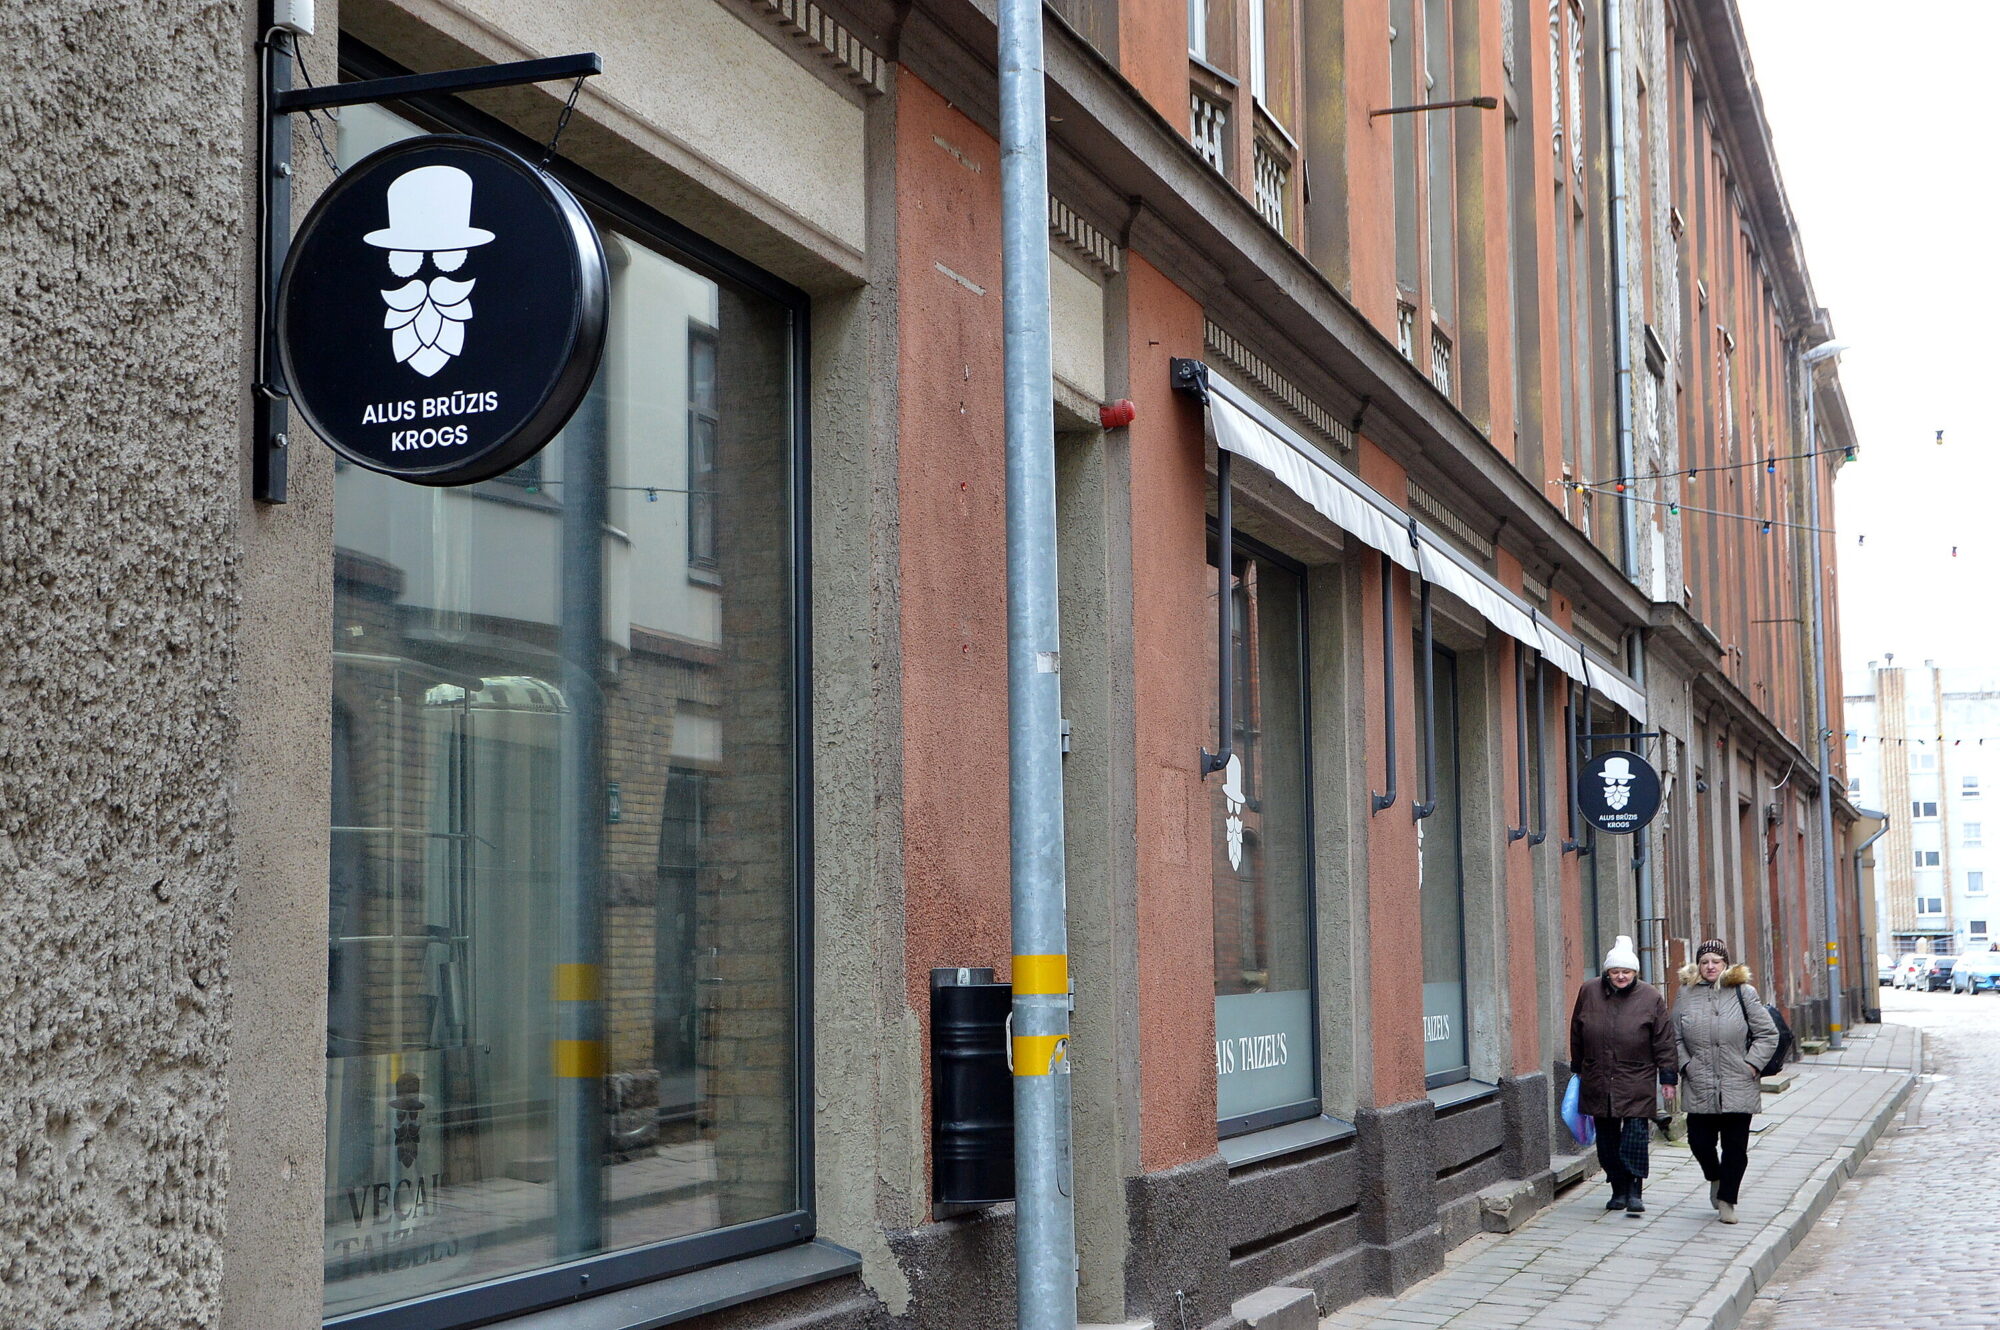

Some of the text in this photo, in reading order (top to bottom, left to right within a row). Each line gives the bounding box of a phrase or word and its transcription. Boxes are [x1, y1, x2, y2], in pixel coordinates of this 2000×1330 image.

[361, 391, 498, 425] ALUS BRŪZIS
[391, 425, 468, 451] KROGS
[1615, 812, 1638, 821] BRŪZIS
[1239, 1032, 1287, 1071] TAIZEL'S
